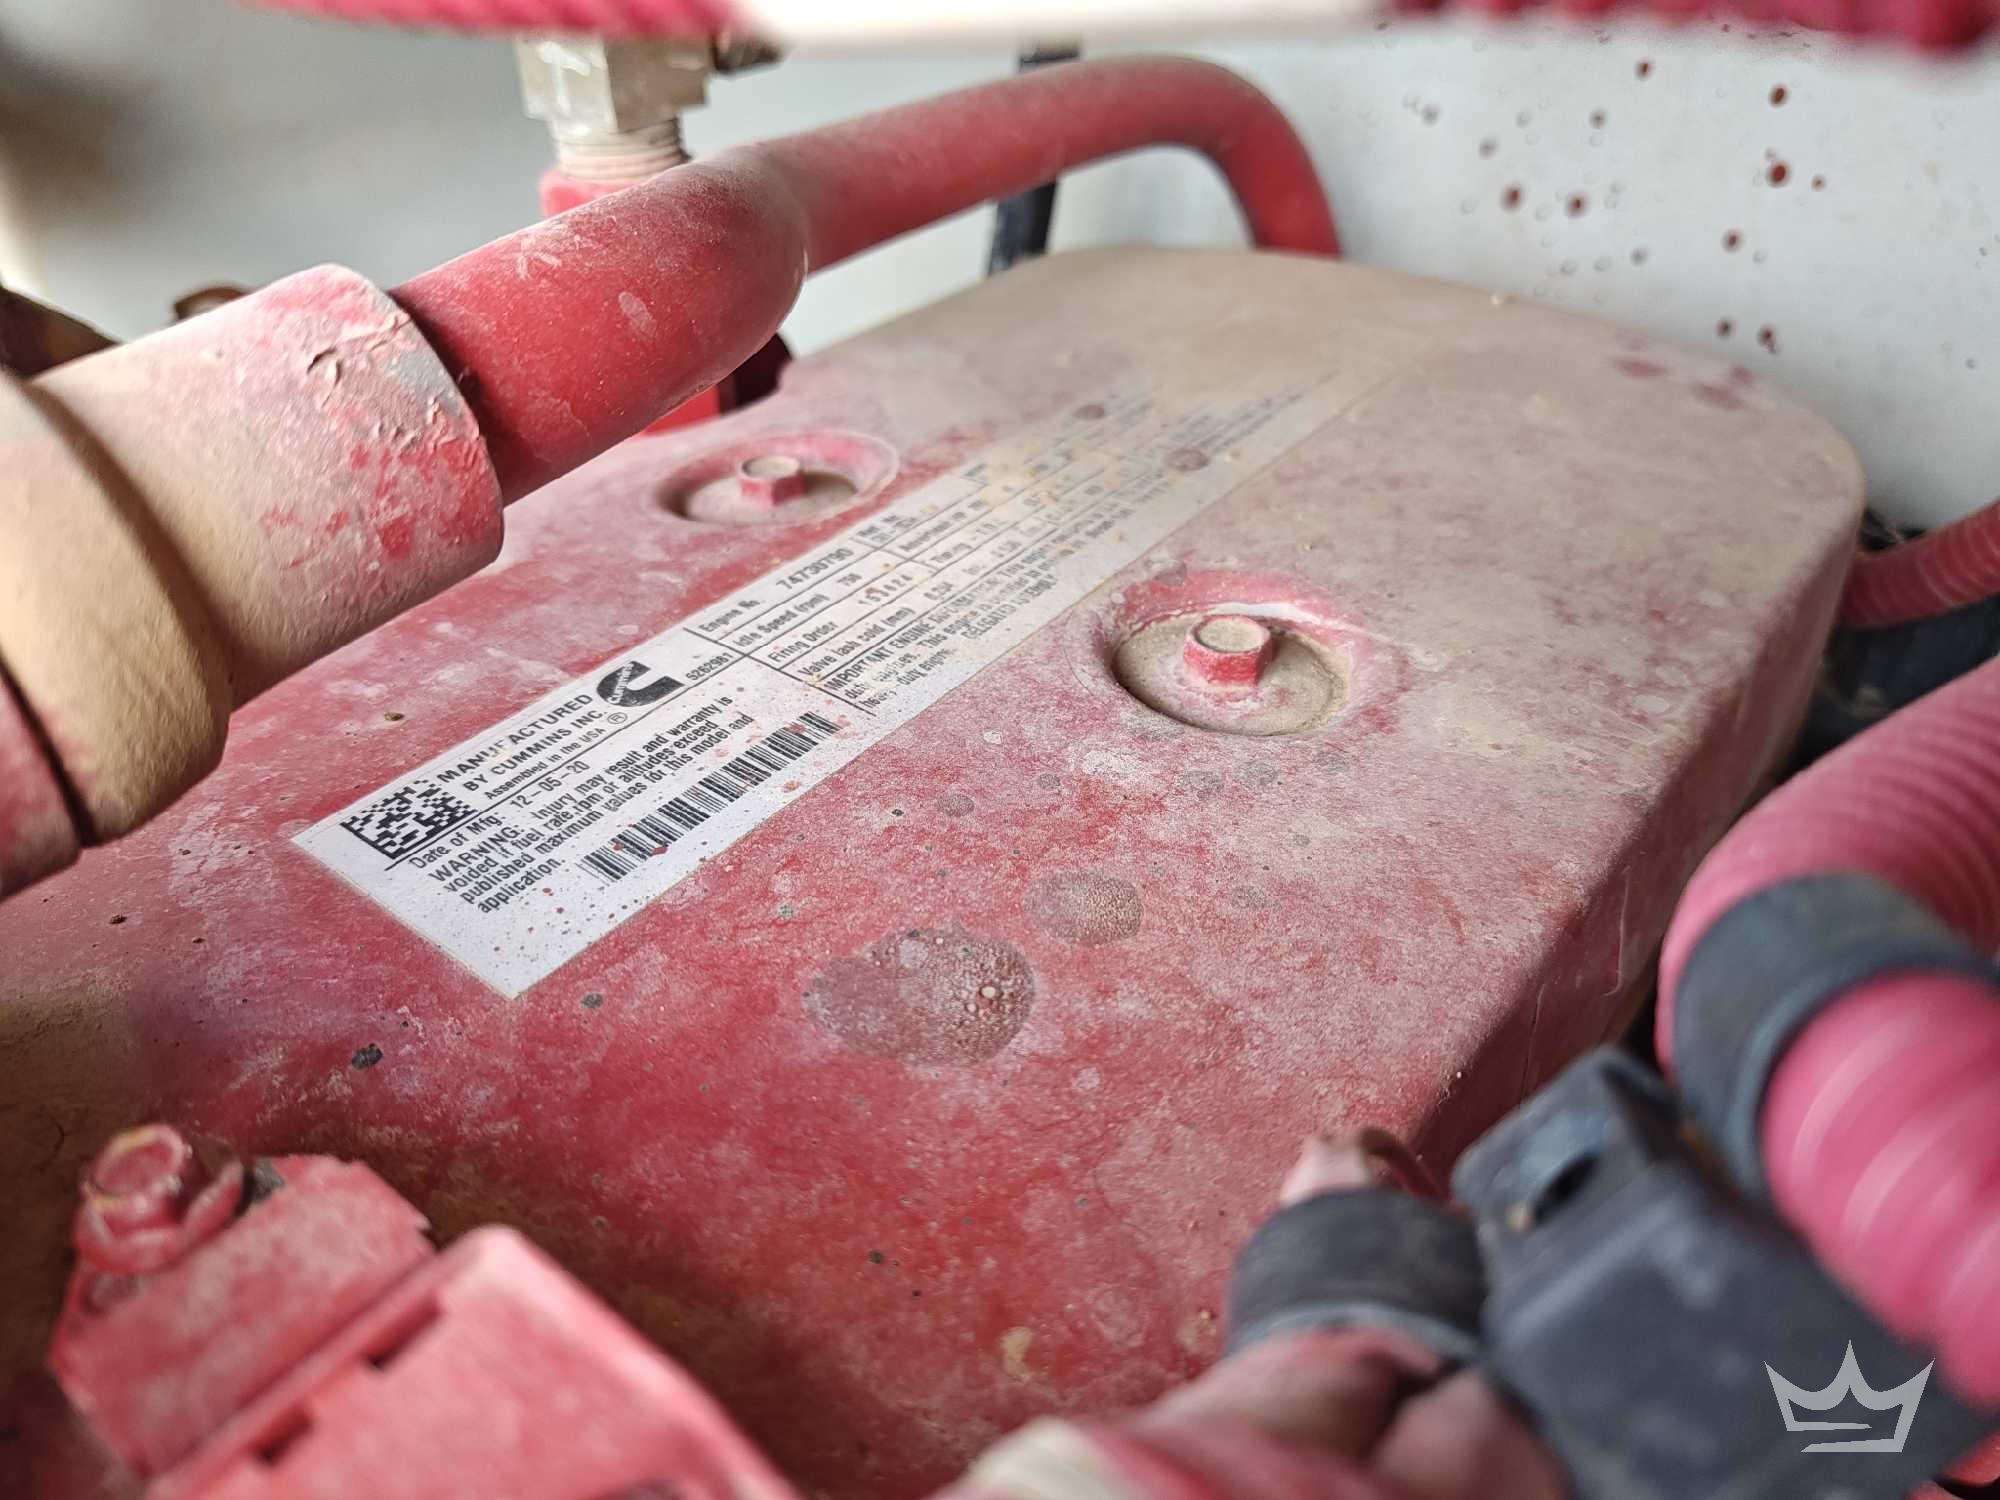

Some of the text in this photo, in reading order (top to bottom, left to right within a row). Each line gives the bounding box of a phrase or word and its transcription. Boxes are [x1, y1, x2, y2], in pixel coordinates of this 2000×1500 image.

[732, 632, 763, 647] Idle
[756, 609, 799, 634] Speed
[767, 621, 839, 663] Firing Order
[821, 643, 895, 691] IMPORTANT
[888, 619, 936, 649] ENGINE
[796, 655, 838, 677] Valve
[462, 710, 608, 792] BY CUMMINS INC.
[483, 761, 549, 800] Assembled
[546, 753, 563, 763] in
[559, 742, 582, 755] the
[578, 727, 607, 743] USA
[427, 696, 734, 882] WARNING: Injury may result and warranty is
[442, 856, 500, 893] voided
[498, 846, 514, 859] if
[510, 828, 545, 851] fuel
[602, 781, 620, 794] or
[617, 747, 676, 783] altitudes
[672, 719, 720, 749] exceed
[459, 710, 756, 905] published maximum values for this model and
[408, 846, 451, 869] Date
[449, 831, 470, 847] of
[465, 812, 506, 835] Mfg:
[477, 858, 566, 914] application.
